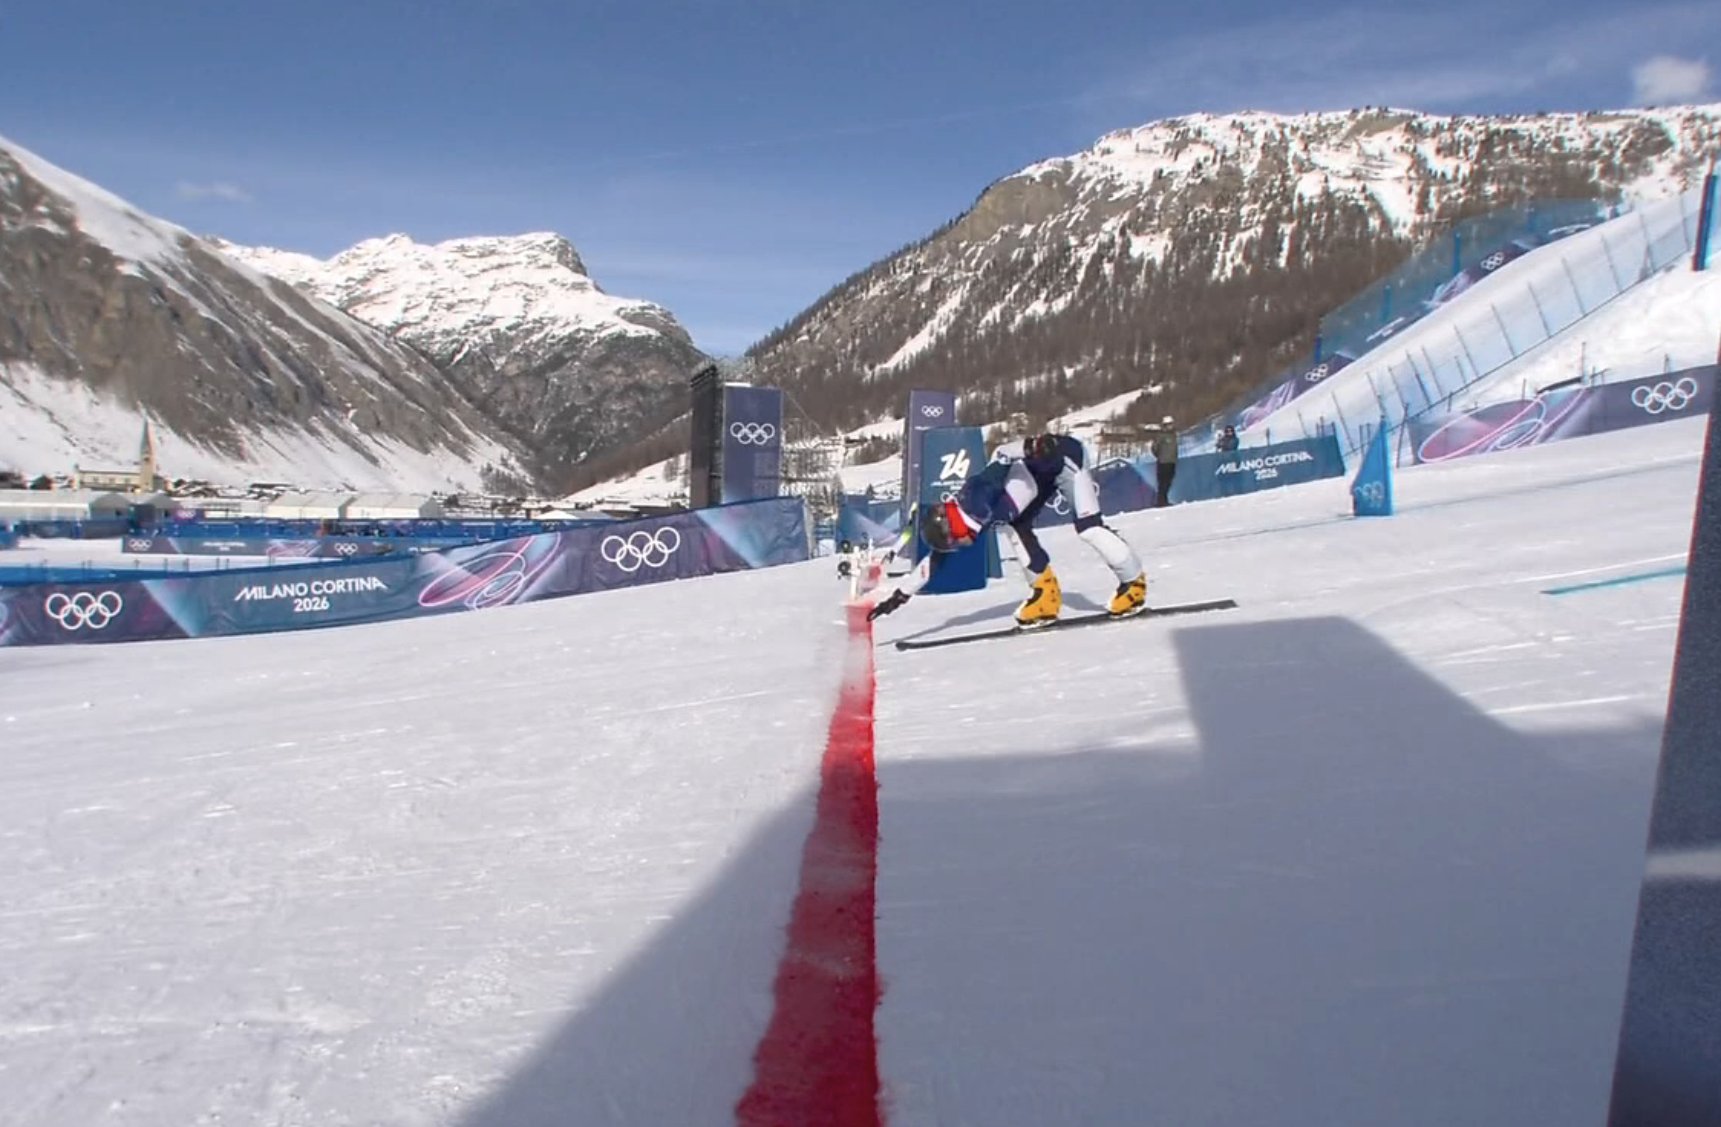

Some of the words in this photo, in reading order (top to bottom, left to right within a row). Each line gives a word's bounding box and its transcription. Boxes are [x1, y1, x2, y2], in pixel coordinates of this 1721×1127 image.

[1215, 459, 1263, 475] MILANO
[1265, 451, 1313, 467] CORTINA
[234, 582, 308, 601] MILANO
[311, 576, 388, 594] CORTINA
[293, 597, 330, 612] 2026
